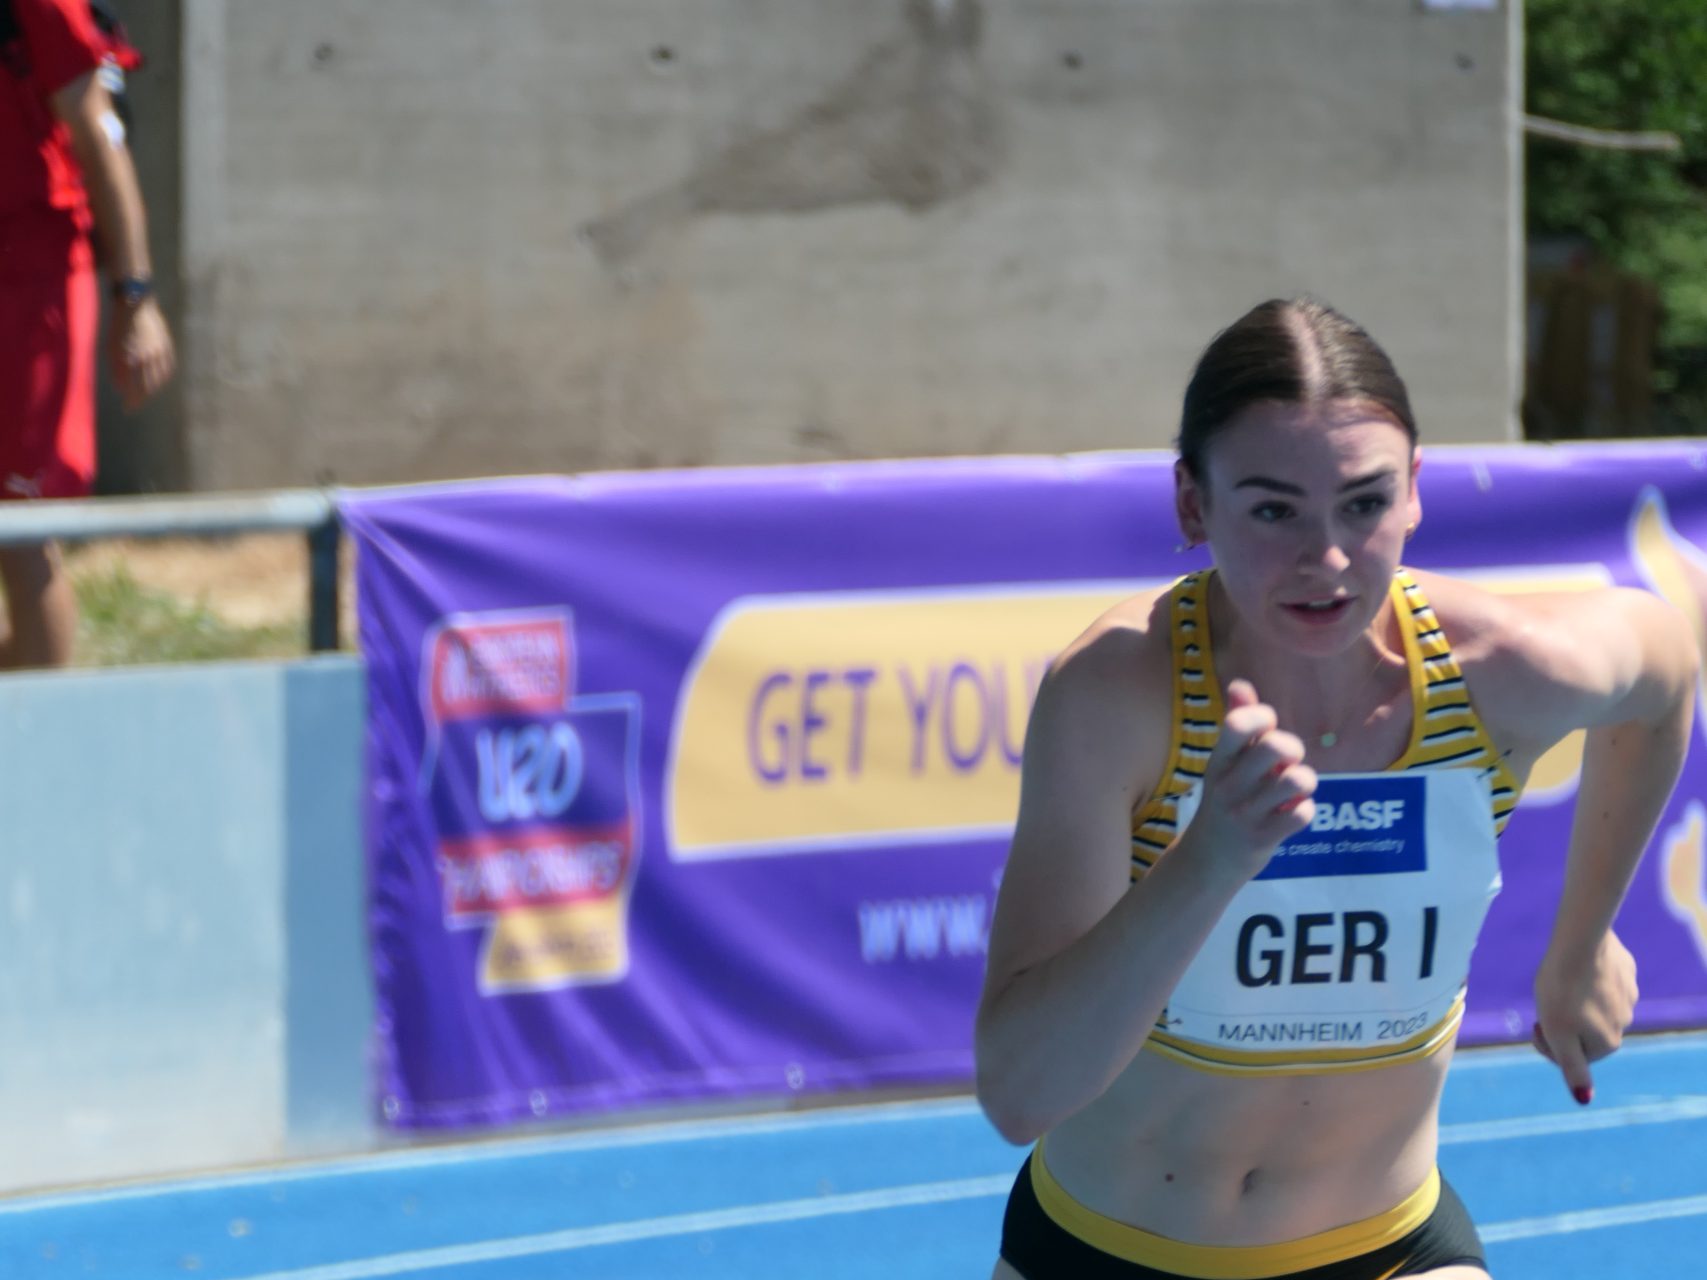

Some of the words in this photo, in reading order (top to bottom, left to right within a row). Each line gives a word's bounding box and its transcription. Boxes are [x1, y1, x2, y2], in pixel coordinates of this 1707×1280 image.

[747, 668, 877, 787] GET
[898, 655, 1056, 777] YOU
[1311, 799, 1405, 832] BASF
[1288, 841, 1332, 856] create
[1334, 838, 1406, 855] chemistry
[1235, 909, 1390, 988] GER
[1218, 1021, 1363, 1043] MANNHEIM
[1376, 1011, 1429, 1041] 2023
